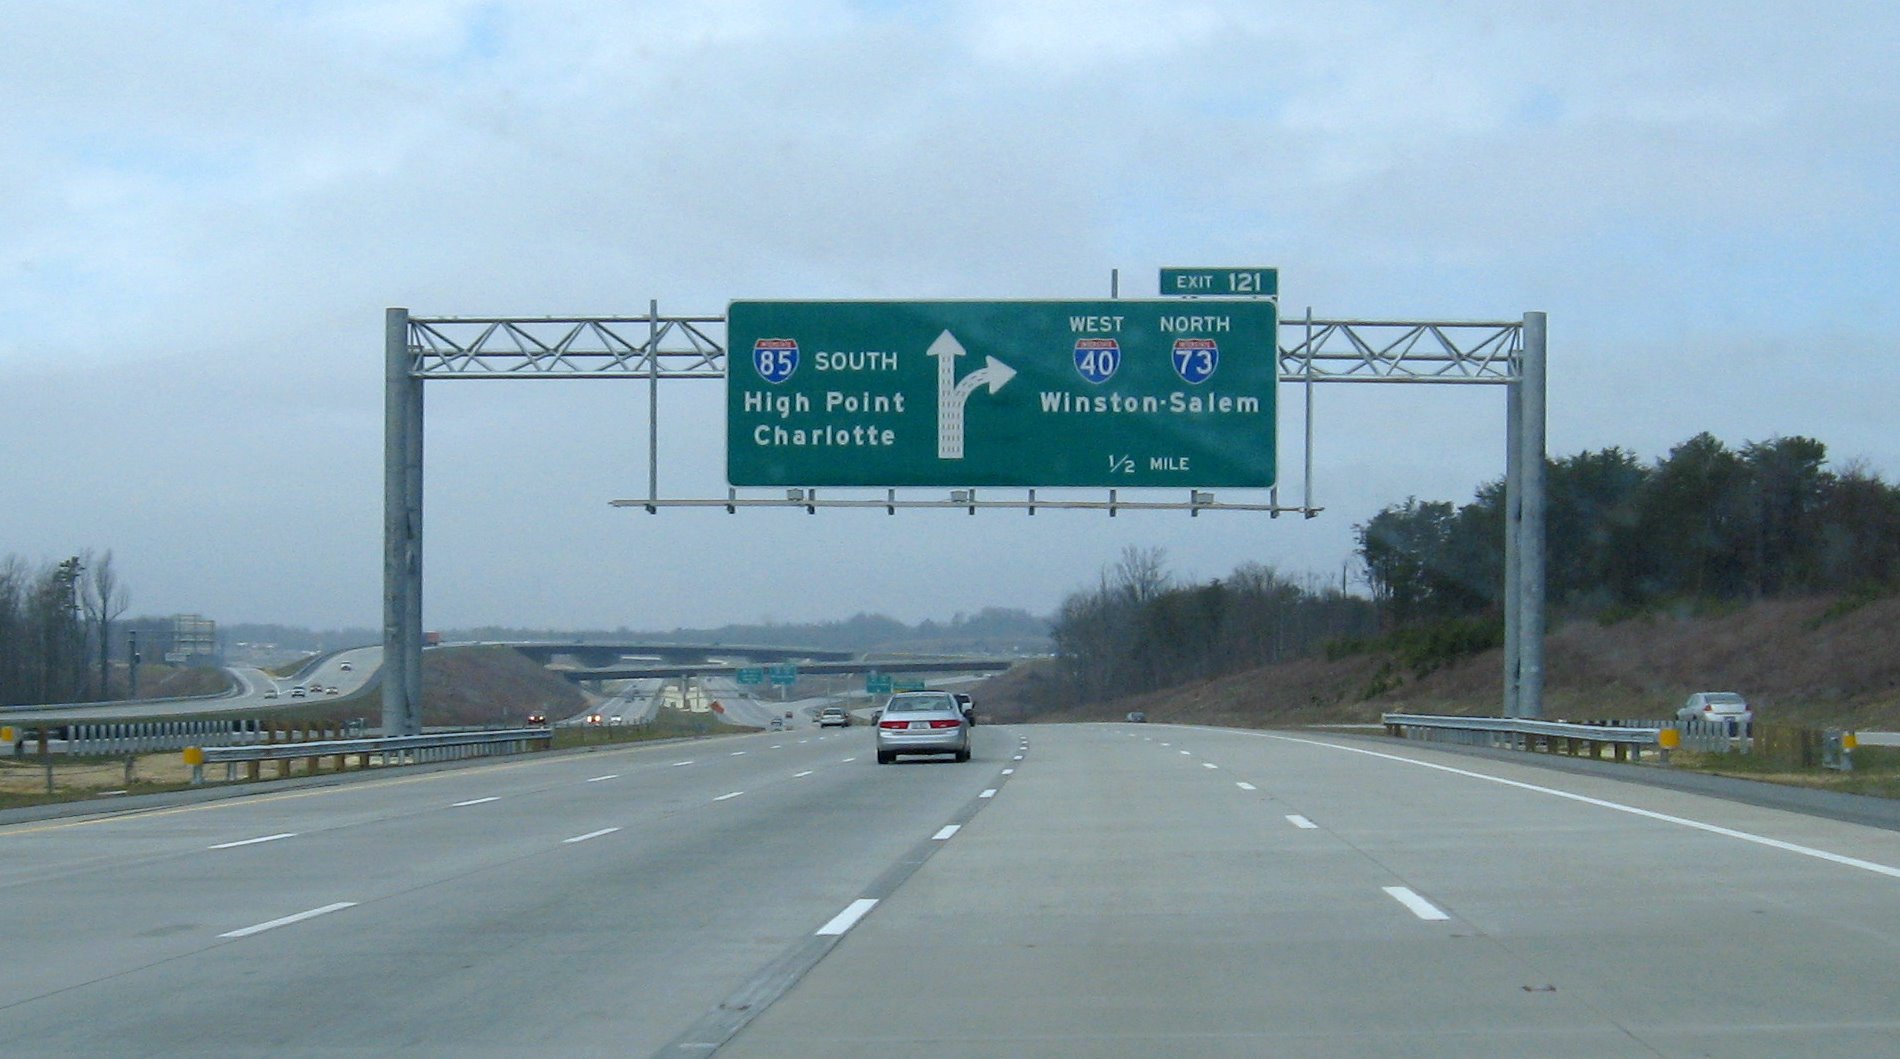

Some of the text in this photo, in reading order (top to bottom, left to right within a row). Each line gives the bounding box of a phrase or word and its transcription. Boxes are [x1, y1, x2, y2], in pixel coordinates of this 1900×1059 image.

[1176, 273, 1262, 292] EXIT 121
[1069, 316, 1125, 332] WEST
[1160, 316, 1231, 332] NORTH
[759, 350, 898, 376] 85 SOUTH
[1079, 350, 1114, 376] 40
[1176, 350, 1213, 375] 73
[744, 391, 905, 418] High Point
[1040, 392, 1260, 413] Winston-Salem
[753, 424, 896, 446] Charlotte
[1149, 457, 1190, 471] MILE
